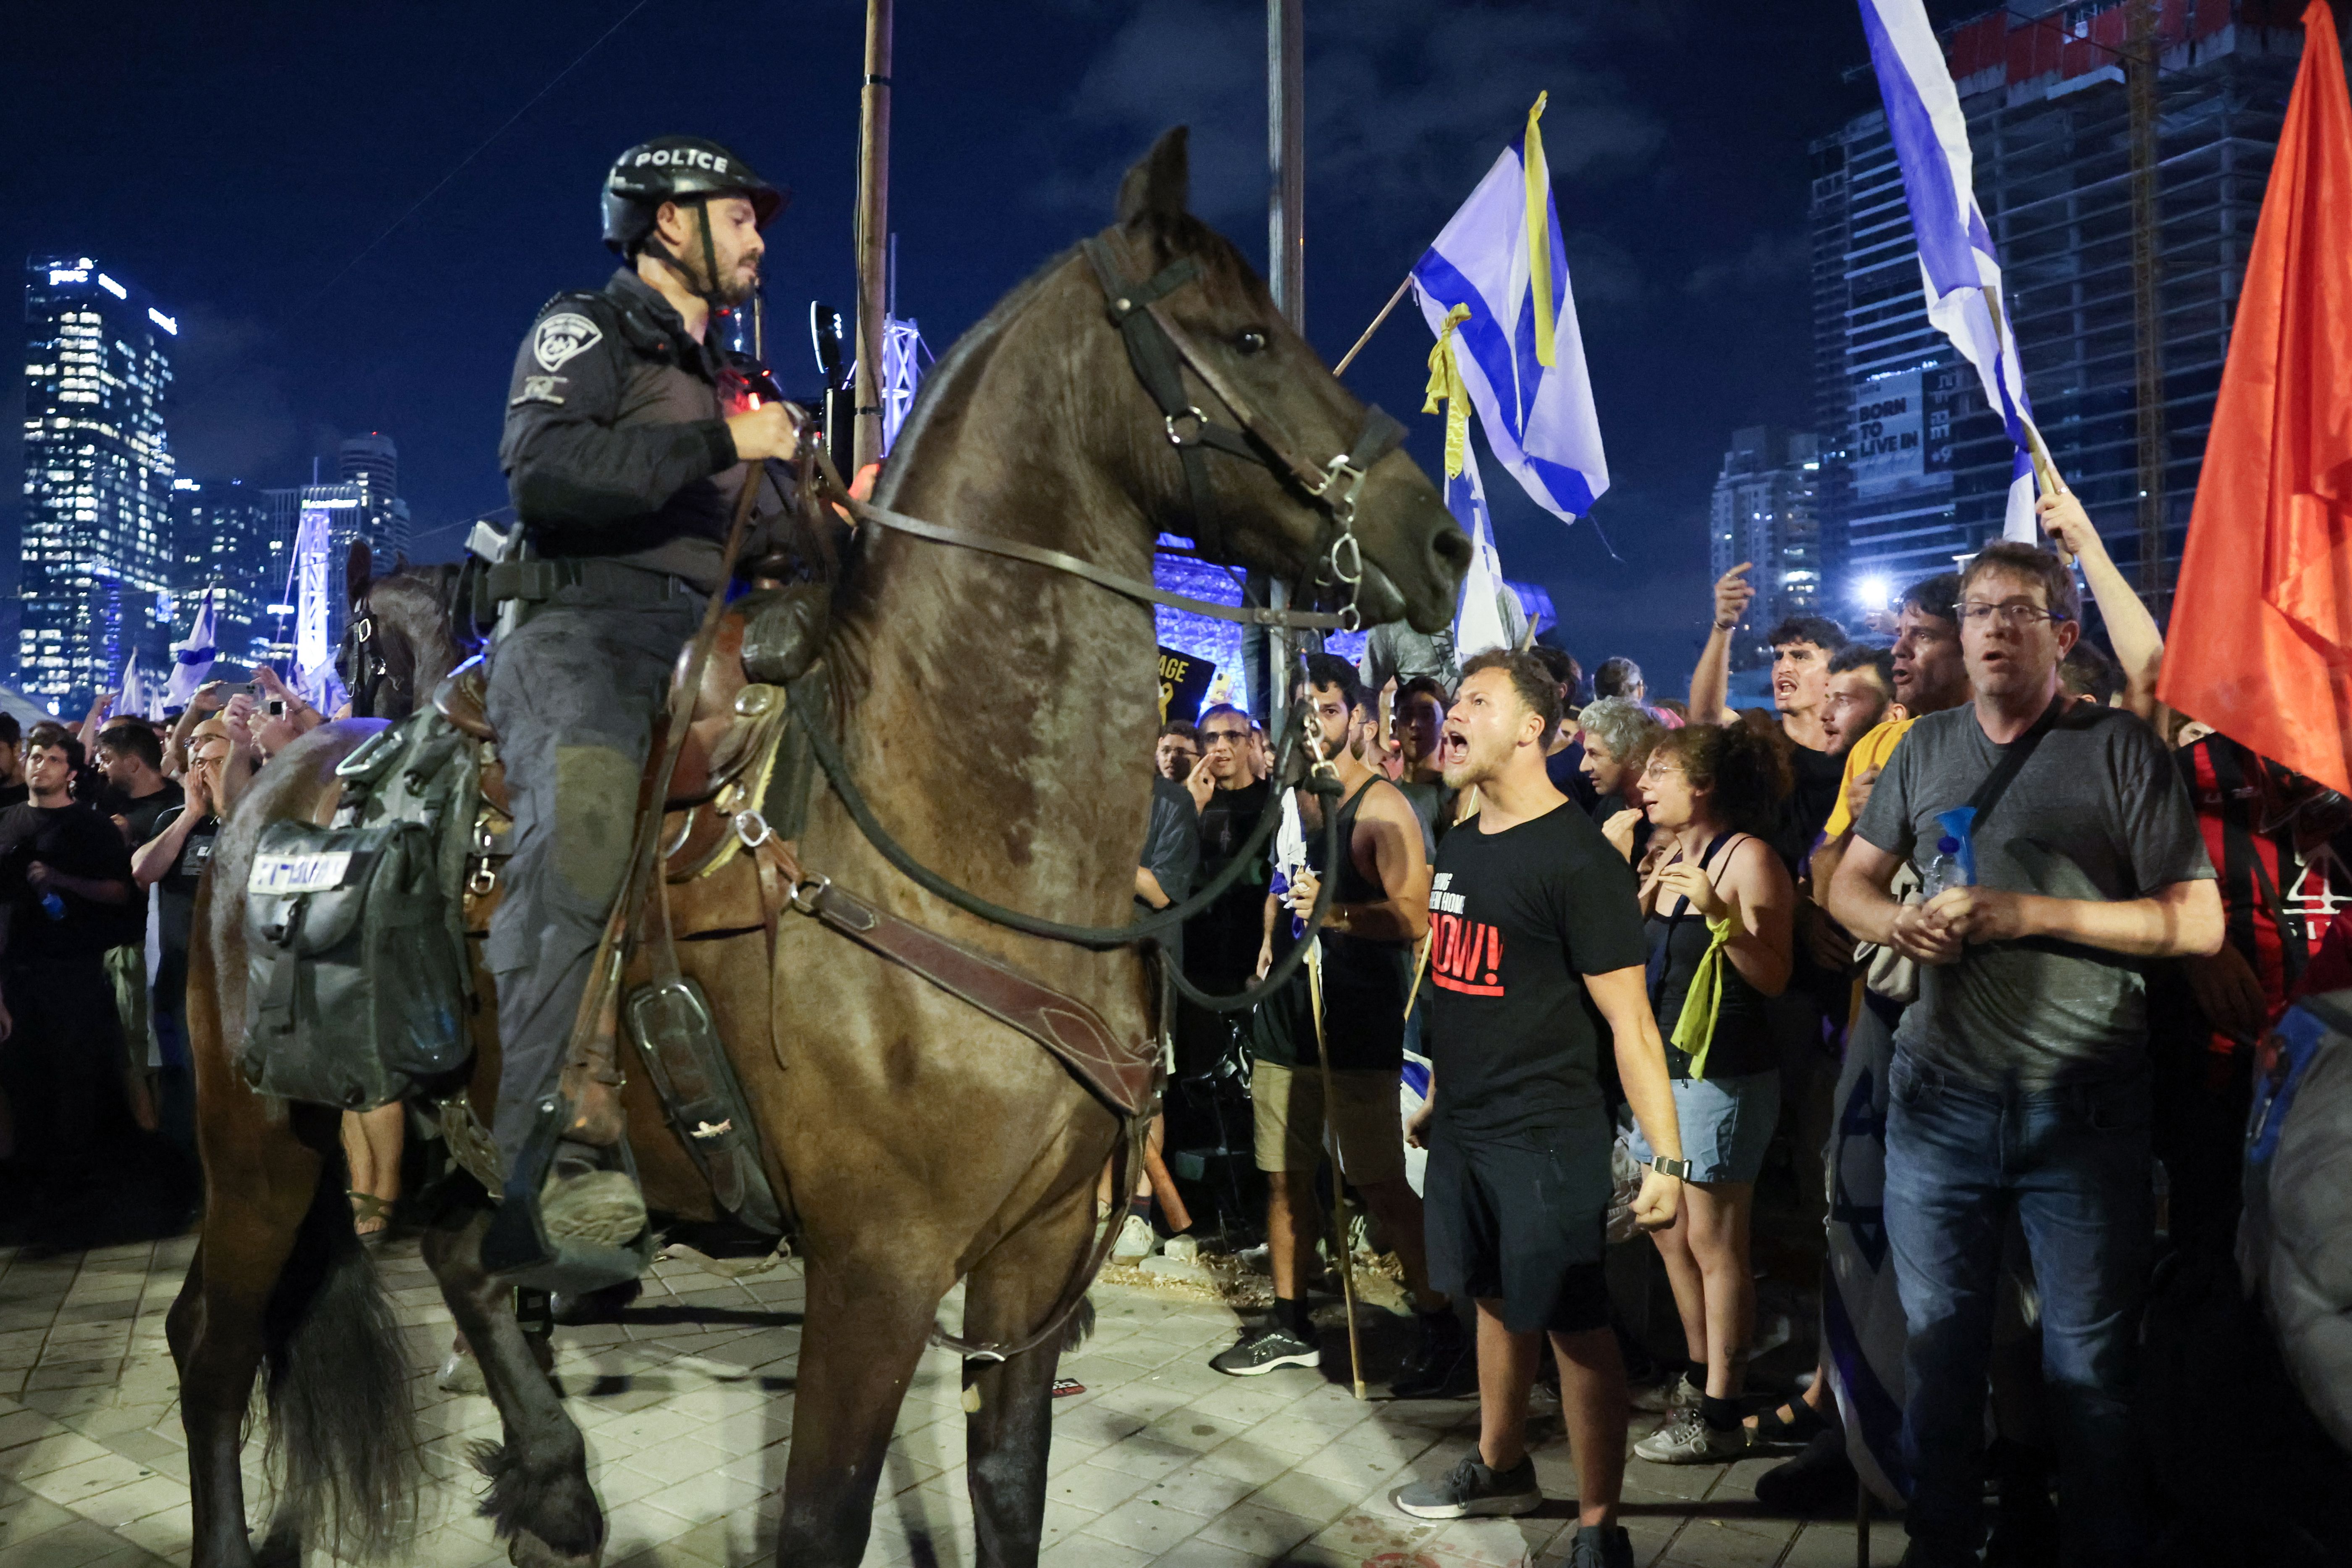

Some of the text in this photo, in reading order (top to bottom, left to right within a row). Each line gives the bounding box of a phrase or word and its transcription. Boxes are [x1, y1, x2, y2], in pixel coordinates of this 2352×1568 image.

[635, 149, 728, 173] POLICE
[1859, 397, 1906, 421] BORN
[1860, 421, 1883, 439] TO
[1860, 431, 1918, 457] LIVE IN
